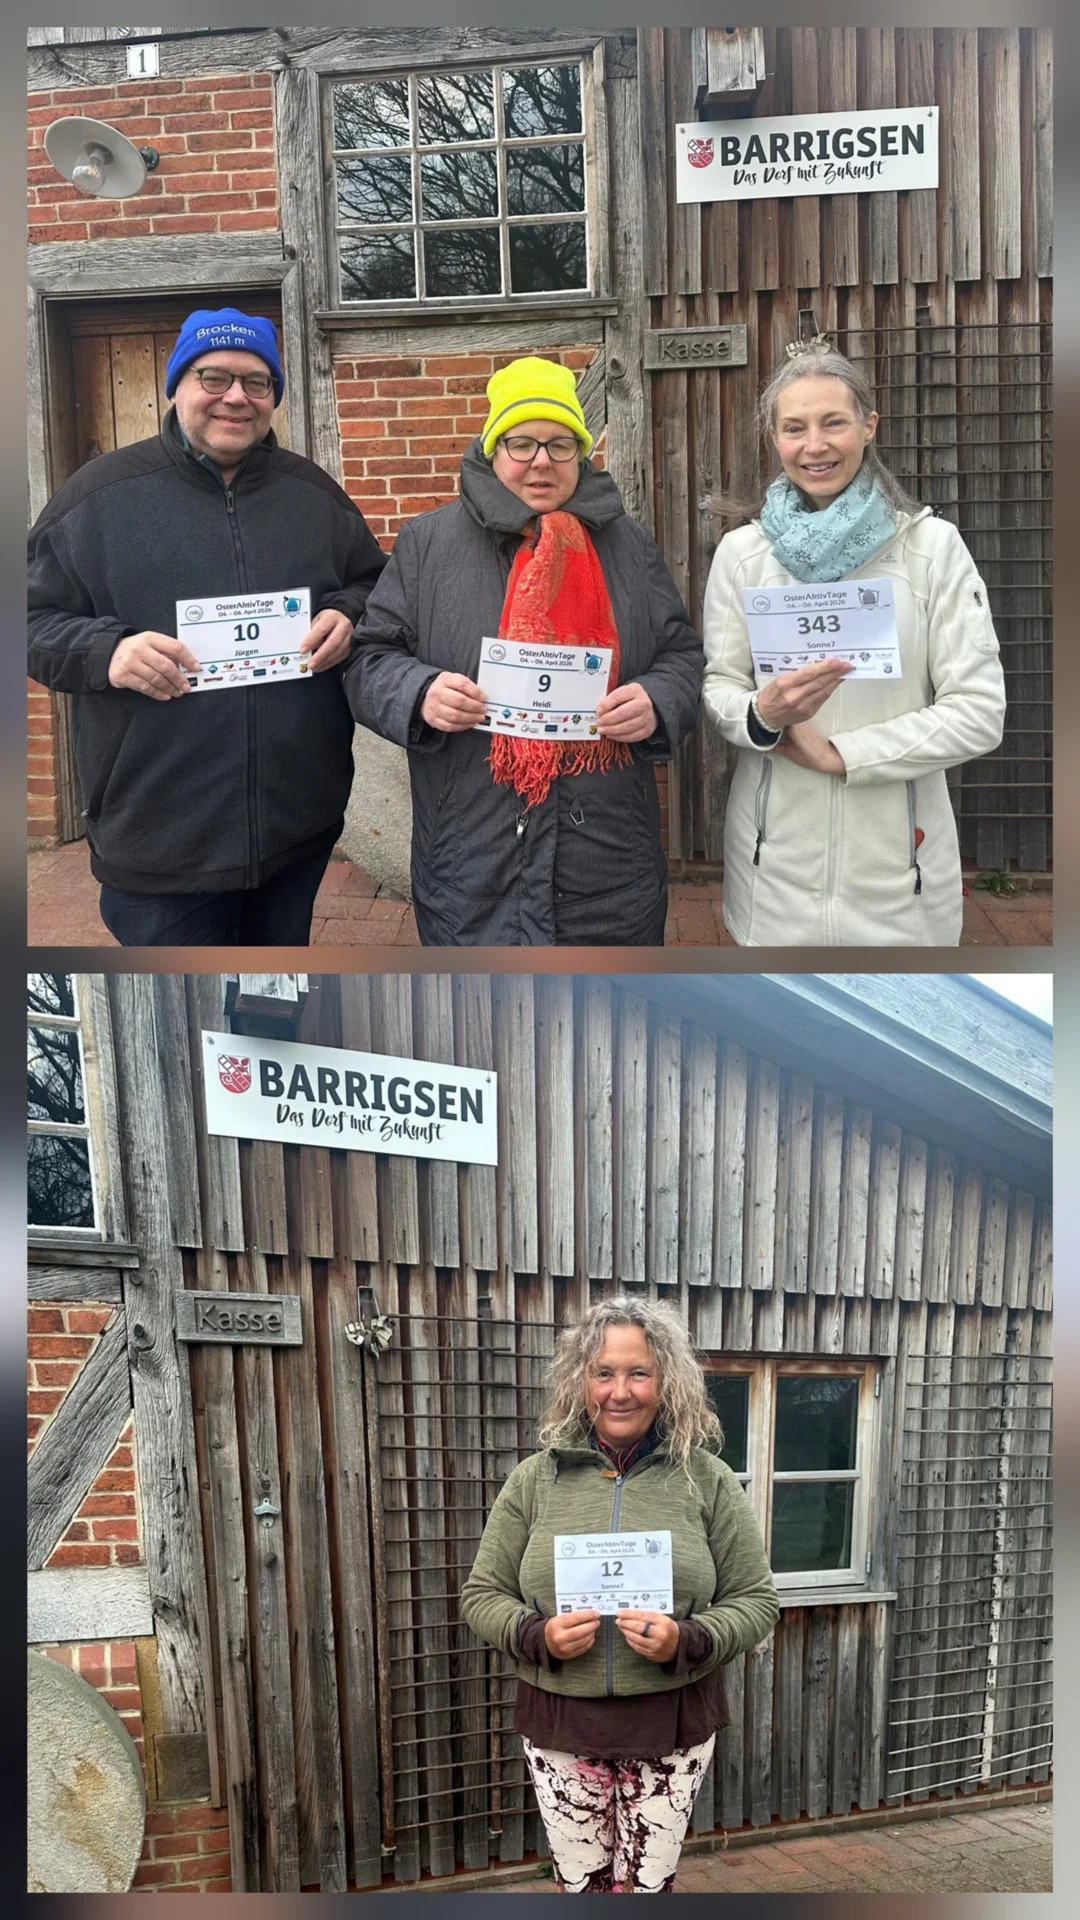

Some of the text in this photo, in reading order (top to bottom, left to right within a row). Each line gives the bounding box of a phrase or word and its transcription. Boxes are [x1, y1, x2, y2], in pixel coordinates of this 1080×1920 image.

[138, 48, 147, 73] 1
[720, 124, 924, 166] BARRIGSEN
[733, 160, 887, 186] Das Dorf mit Zukunft
[196, 323, 256, 339] Brocken
[210, 335, 245, 346] 1141 m
[661, 337, 729, 360] Kasse
[234, 623, 260, 641] 10
[797, 615, 841, 634] 343
[807, 641, 836, 649] Sonne7
[538, 674, 551, 692] 9
[259, 1059, 483, 1124] BARRIGSEN
[276, 1103, 446, 1144] Das Dorf mit Zukunft
[199, 1304, 281, 1332] Kasse
[601, 1561, 624, 1577] 12
